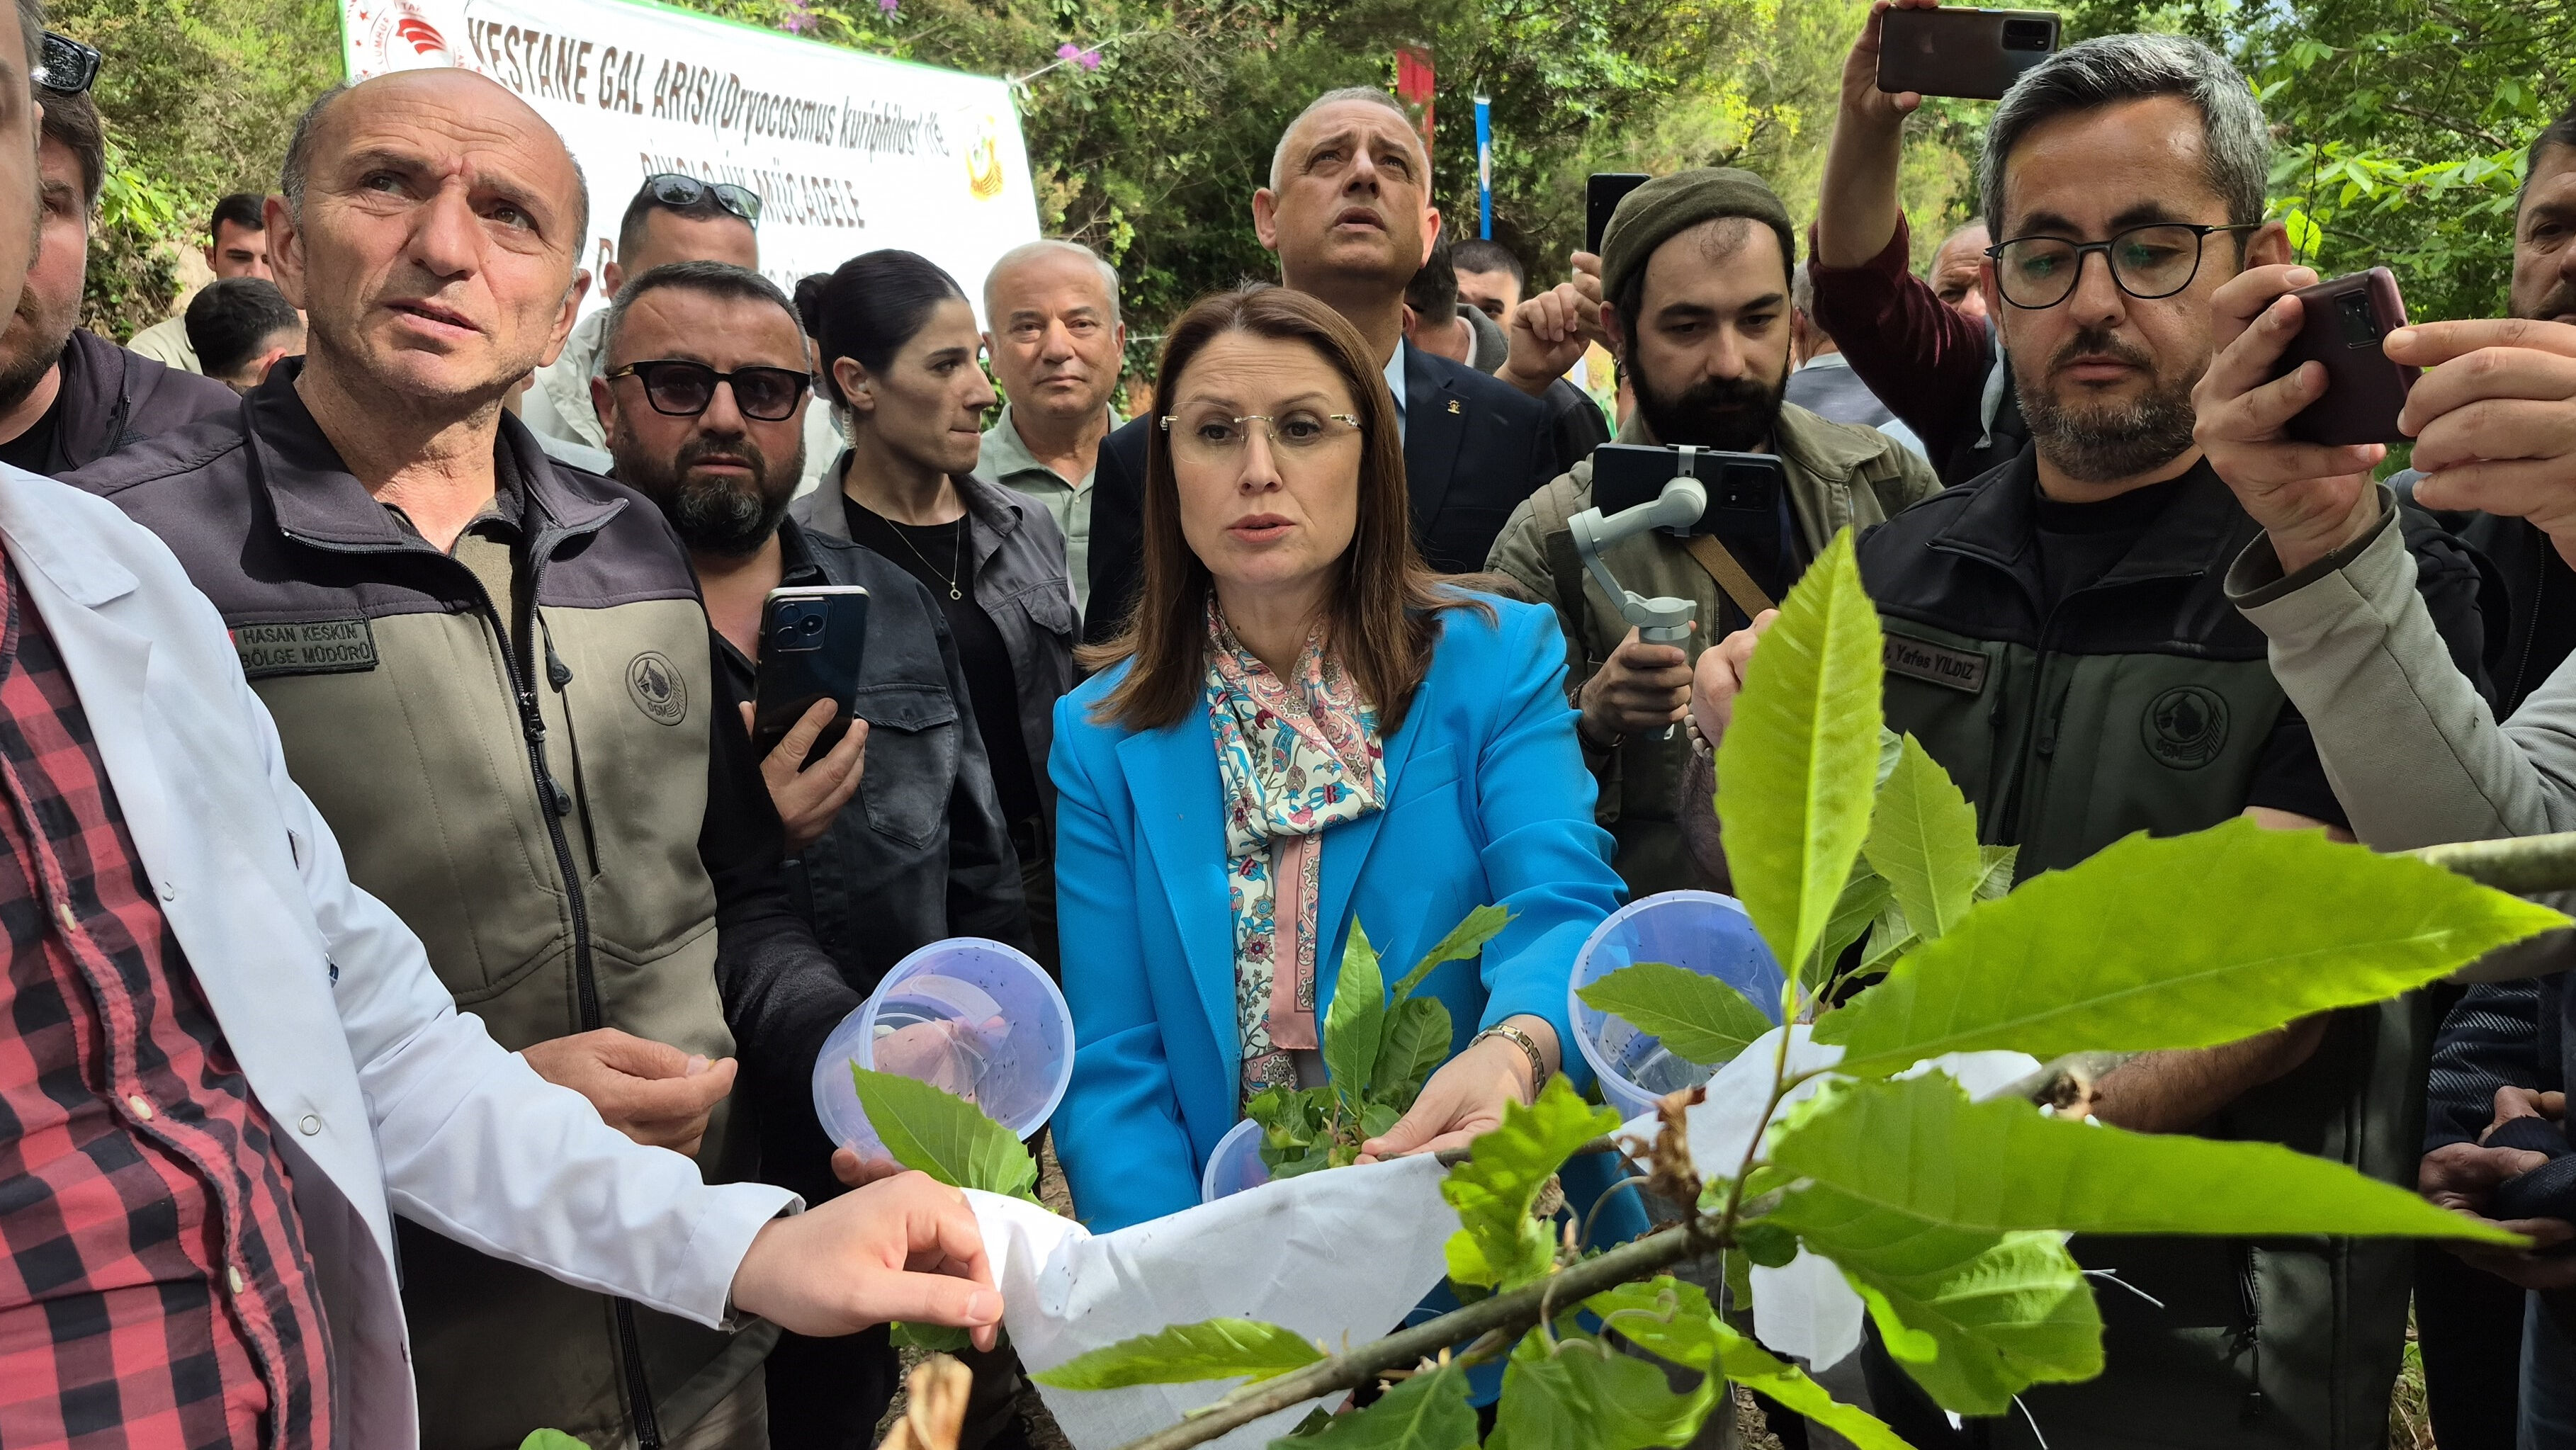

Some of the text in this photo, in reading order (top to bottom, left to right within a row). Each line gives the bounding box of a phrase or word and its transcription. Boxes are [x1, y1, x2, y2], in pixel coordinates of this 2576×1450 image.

[599, 45, 645, 115] GAL
[243, 627, 298, 645] HASAN
[240, 647, 298, 669] BÖLGE
[1935, 654, 1975, 680] YILDIZ
